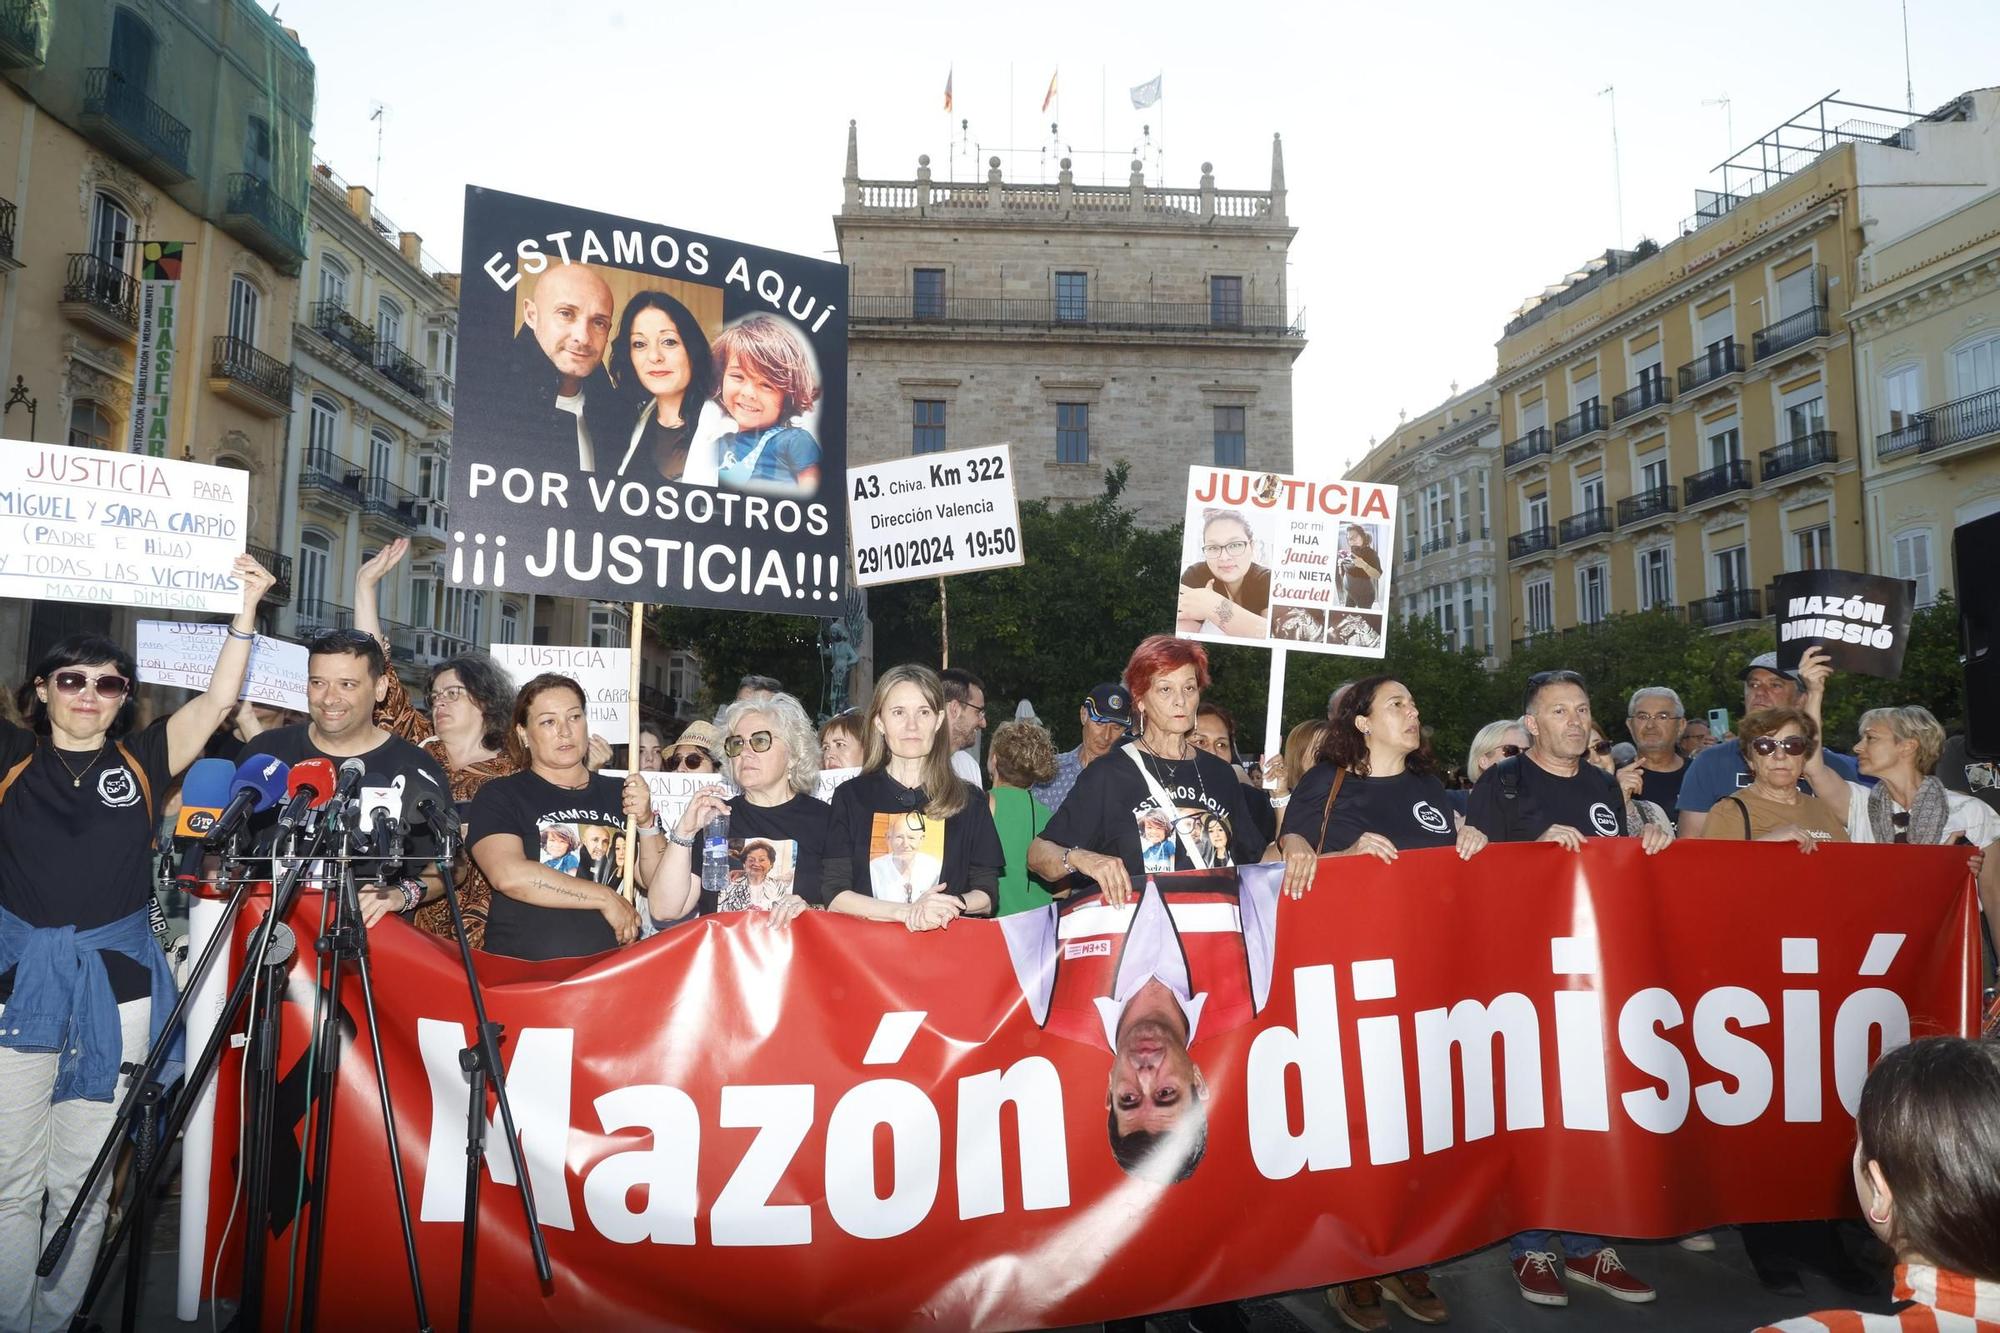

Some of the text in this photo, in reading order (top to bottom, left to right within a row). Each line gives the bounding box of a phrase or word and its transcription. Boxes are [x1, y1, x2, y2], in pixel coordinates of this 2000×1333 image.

[484, 229, 836, 333] ESTAMOS AQUÍ
[27, 452, 233, 501] JUSTICIA PARA
[854, 456, 1005, 501] A3. Chiva. Km 322
[0, 487, 236, 537] MIGUEL Y SARA CARPIO
[469, 463, 829, 537] POR VOSOTROS
[871, 499, 994, 530] Dirección Valencia
[1290, 521, 1324, 531] por mi
[1293, 534, 1319, 546] HIJA
[857, 527, 1016, 574] 29/10/2024 19:50
[1281, 548, 1329, 566] Janine
[24, 555, 92, 578] TODAS
[105, 562, 139, 582] LAS
[1283, 570, 1296, 579] mi
[1299, 571, 1331, 583] NIETA
[1788, 594, 1886, 624] MAZÓN
[1780, 618, 1894, 650] DIMISSIÓ
[1132, 786, 1196, 813] STMOS
[416, 932, 1911, 1247] Mazón dimissió
